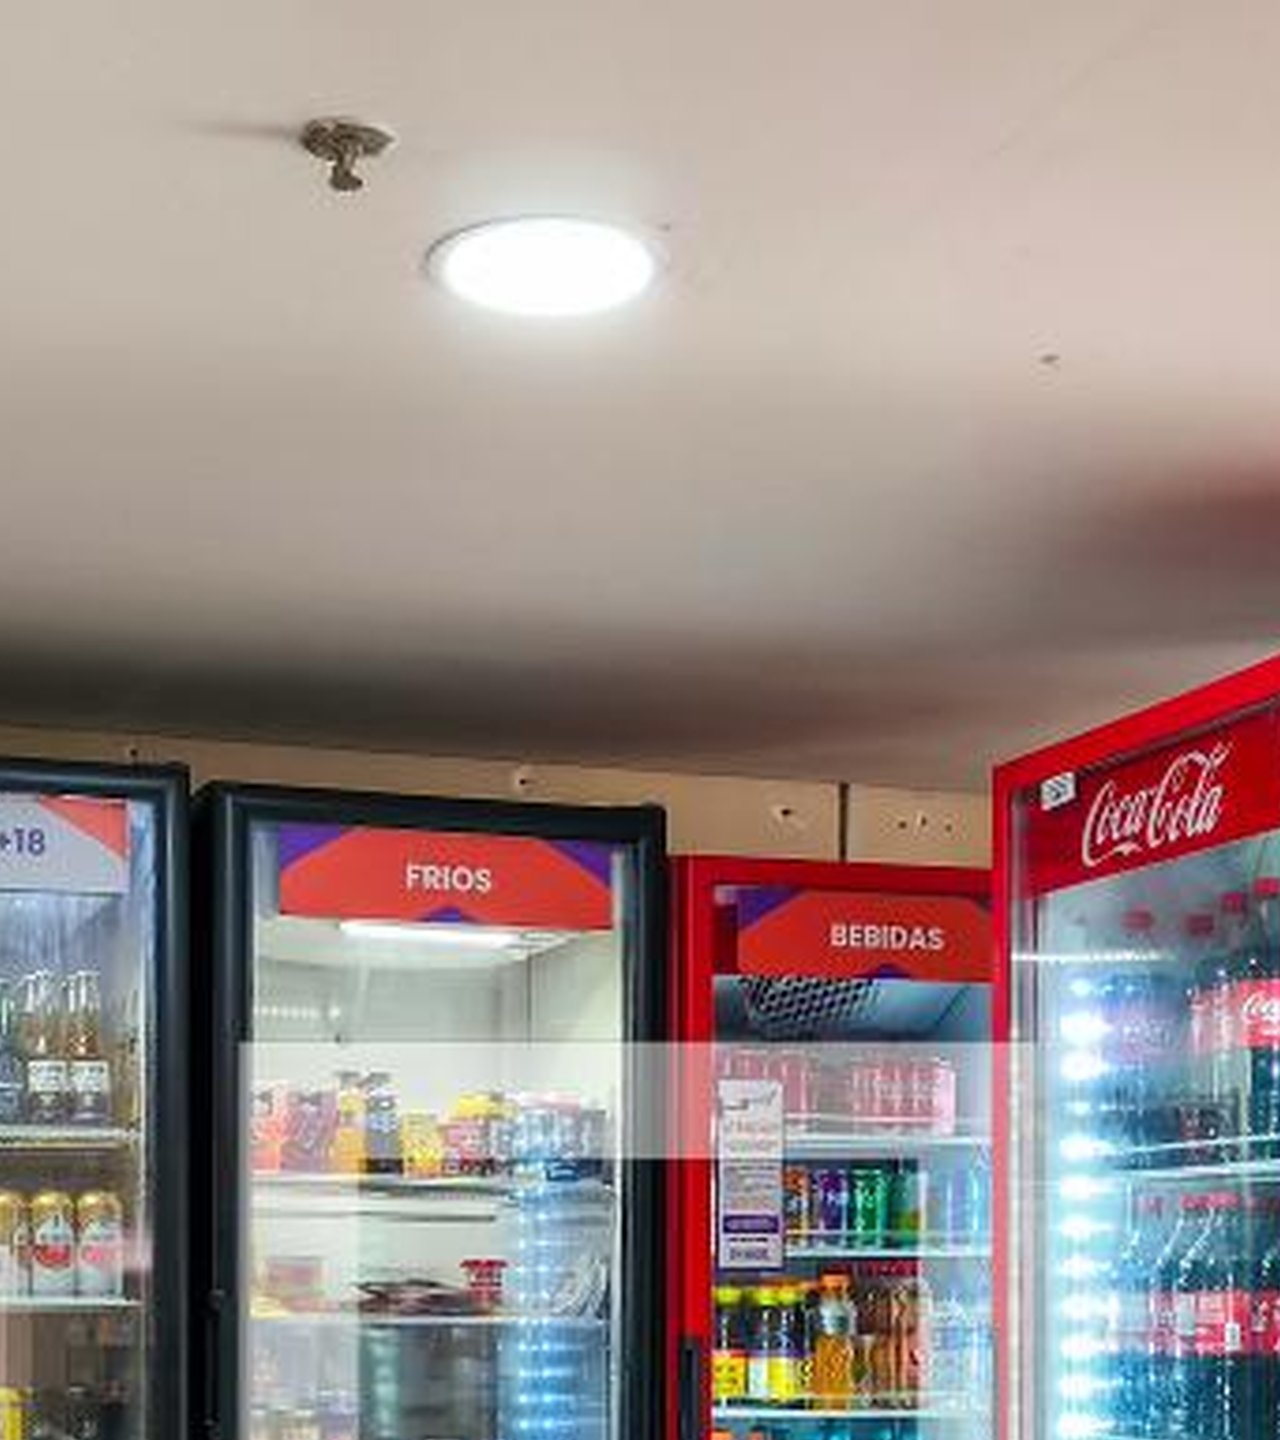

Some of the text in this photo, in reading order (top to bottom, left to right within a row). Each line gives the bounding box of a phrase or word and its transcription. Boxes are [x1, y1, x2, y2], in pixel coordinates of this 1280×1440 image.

[1082, 741, 1234, 867] Coca-Cola
[405, 863, 492, 894] FRIOS
[830, 923, 946, 951] BEBIDAS
